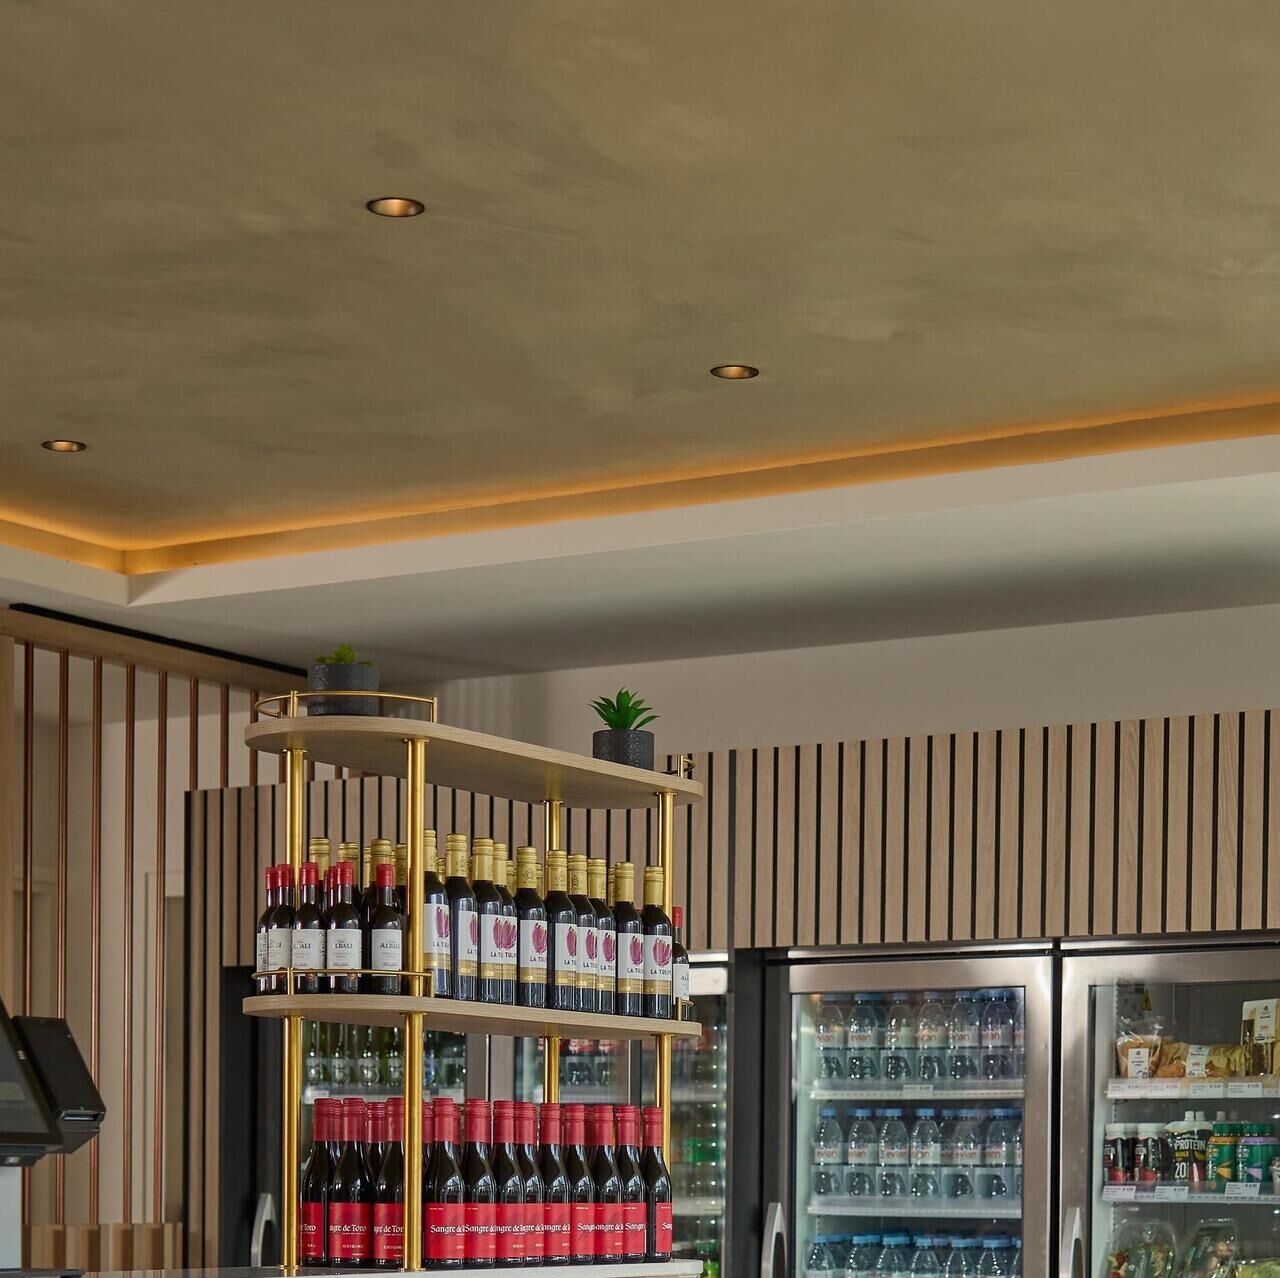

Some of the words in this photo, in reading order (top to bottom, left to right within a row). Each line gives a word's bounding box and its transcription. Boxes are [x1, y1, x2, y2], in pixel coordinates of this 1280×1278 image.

[1174, 1140, 1206, 1150] PROTEIN
[429, 1224, 455, 1234] Sangre
[464, 1223, 489, 1234] Sangre
